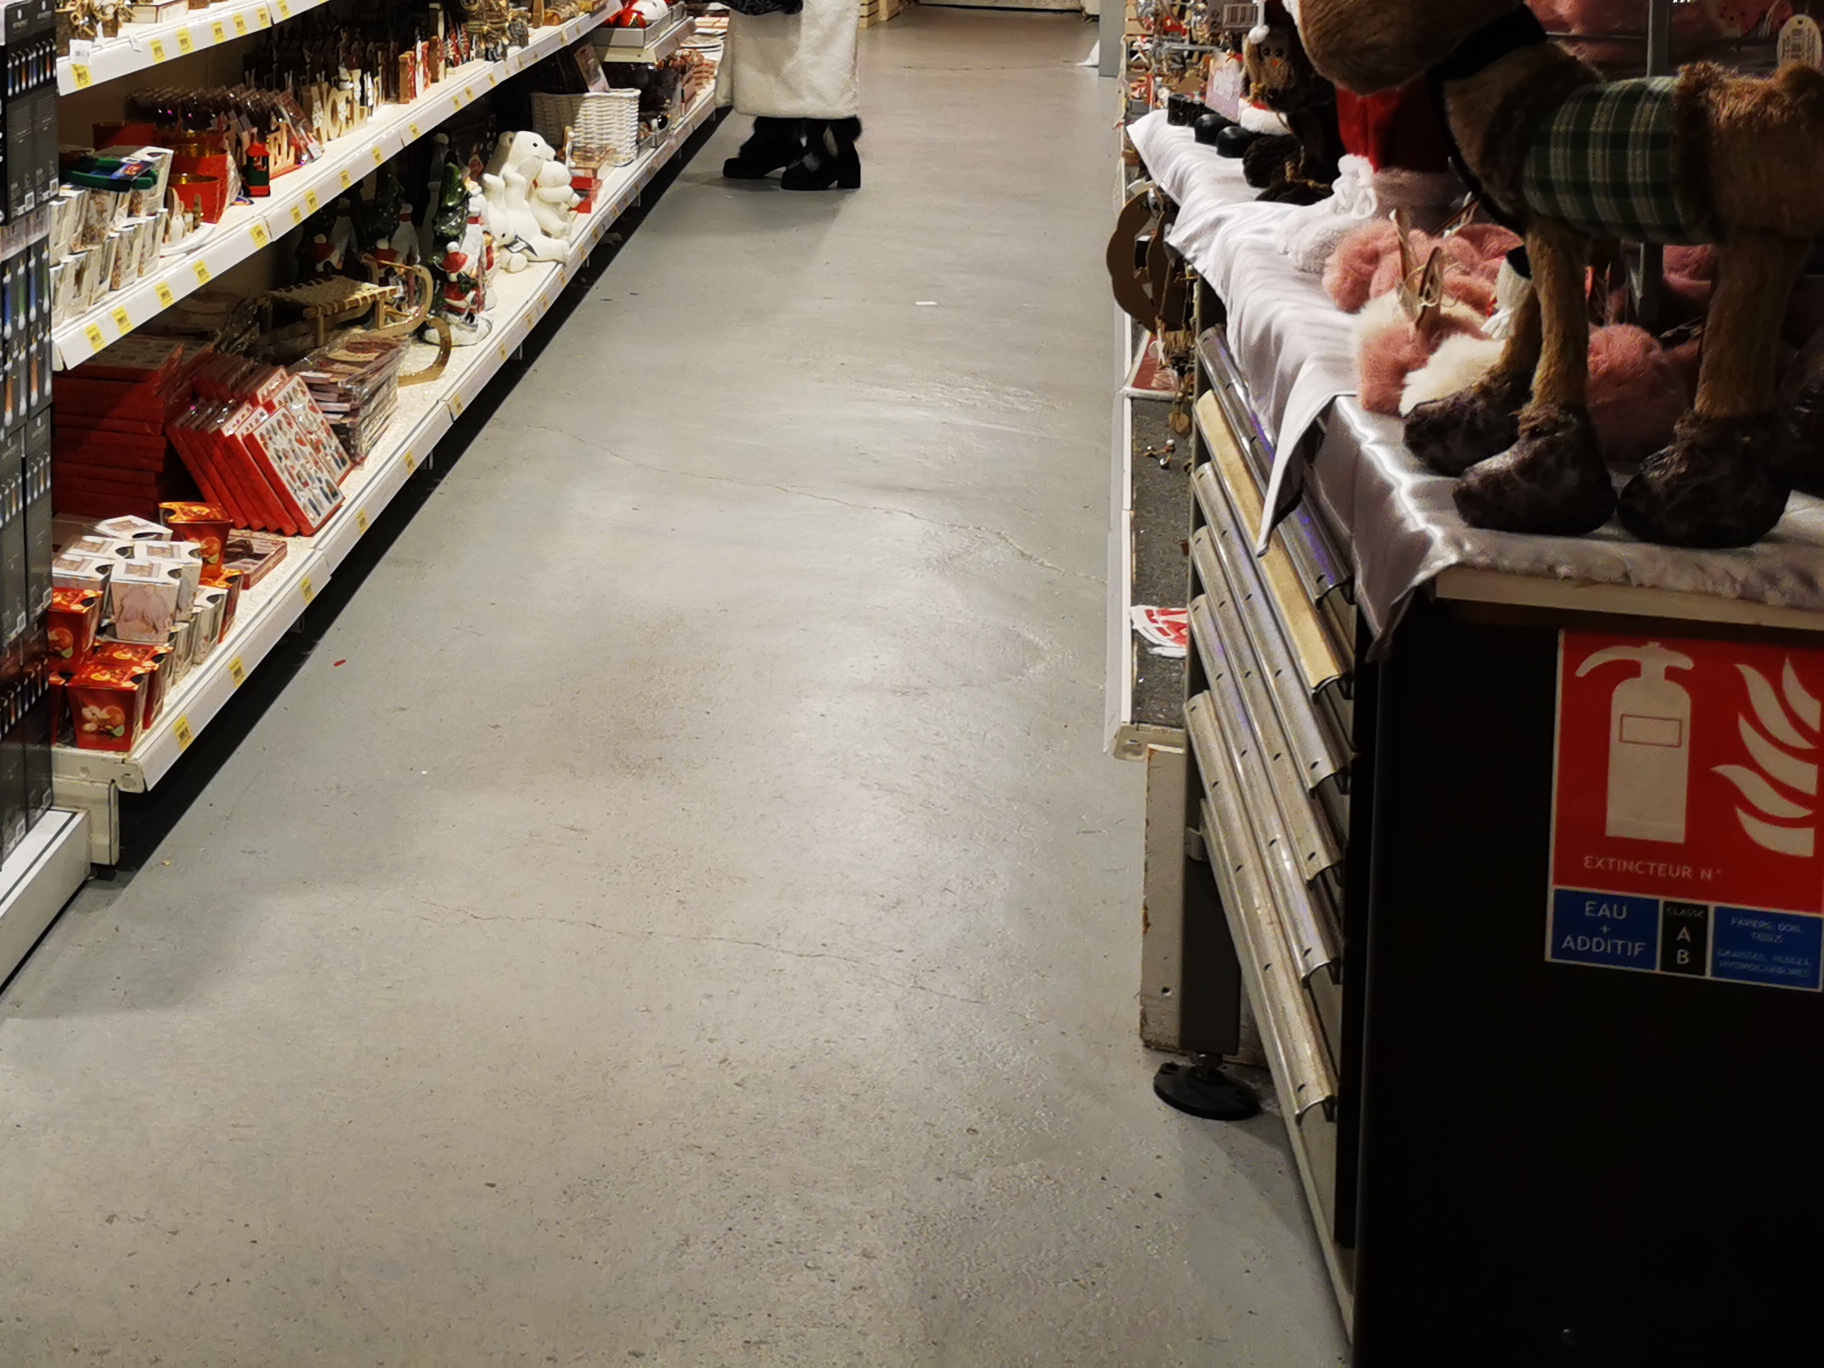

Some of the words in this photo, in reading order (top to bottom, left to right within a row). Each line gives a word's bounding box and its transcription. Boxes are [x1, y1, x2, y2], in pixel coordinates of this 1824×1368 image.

[1583, 855, 1692, 879] EXTINCTEUR
[1584, 901, 1628, 920] EAU
[1675, 925, 1691, 942] A
[1561, 934, 1647, 957] ADDITIF
[1676, 948, 1690, 965] B
